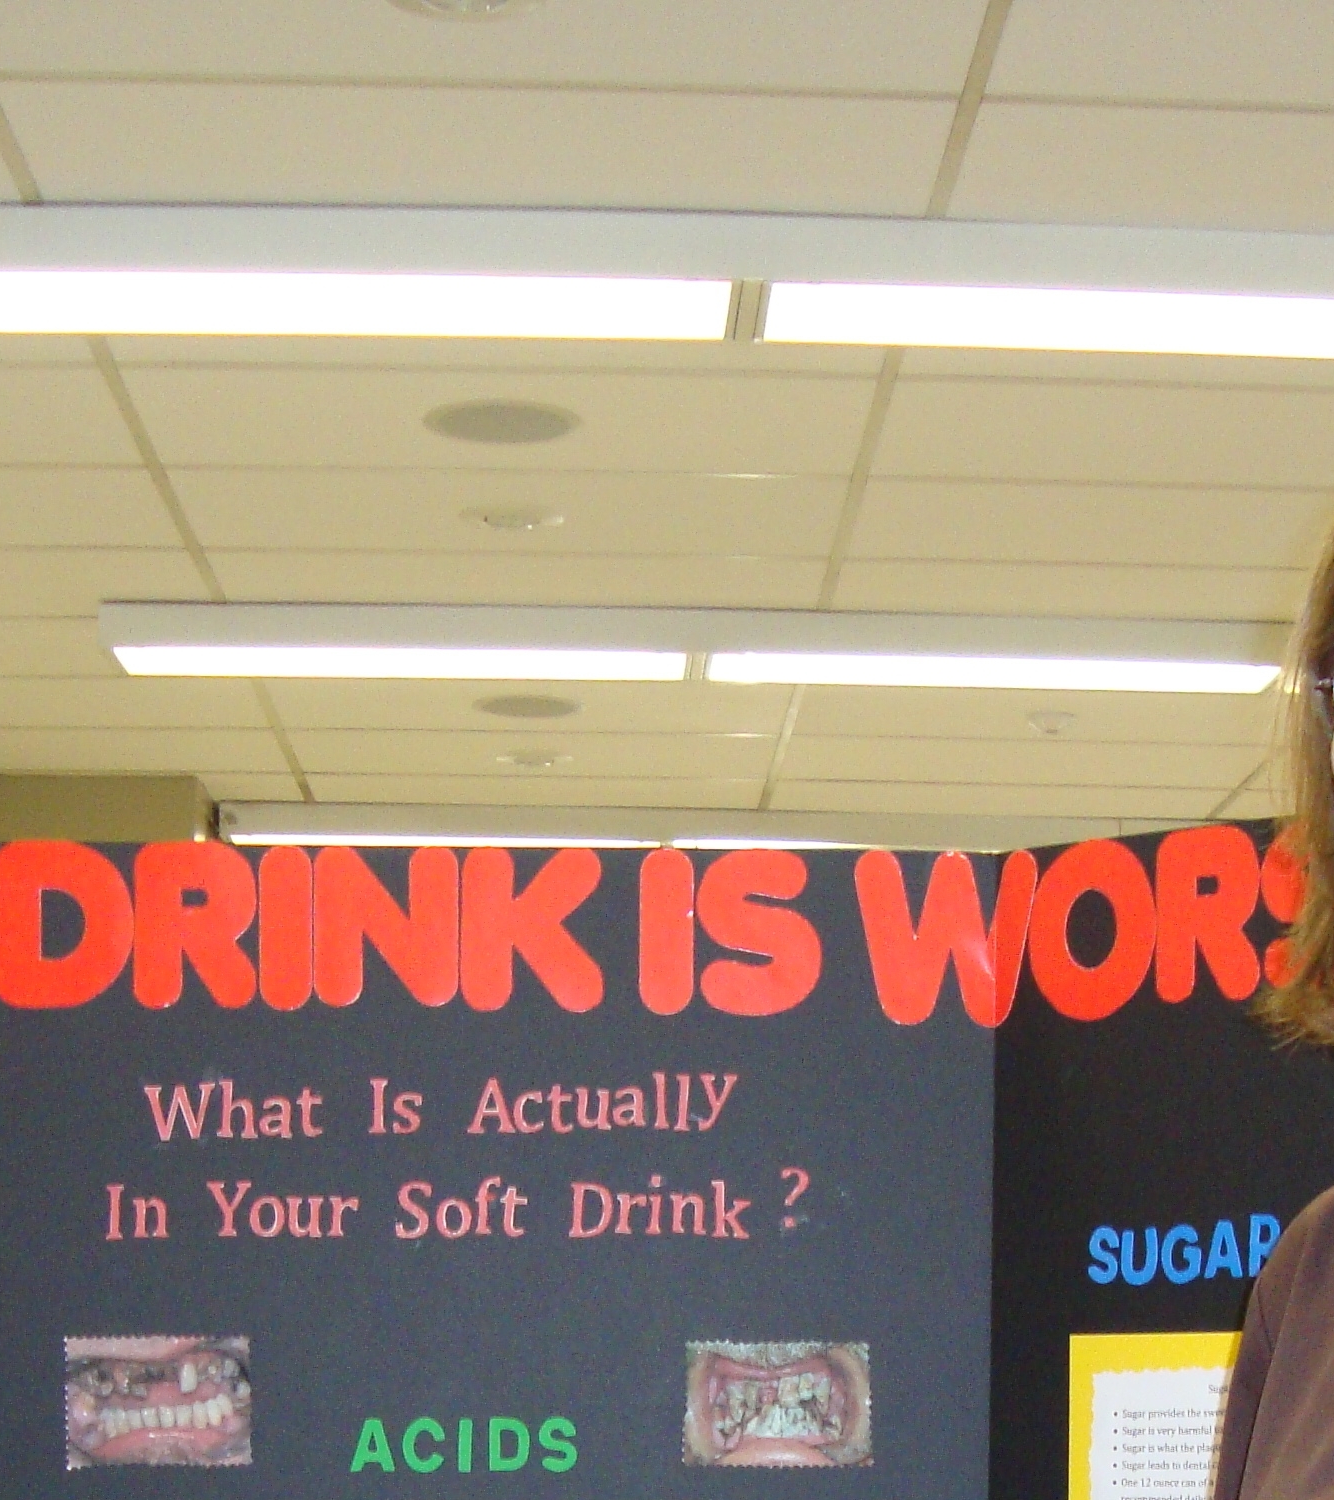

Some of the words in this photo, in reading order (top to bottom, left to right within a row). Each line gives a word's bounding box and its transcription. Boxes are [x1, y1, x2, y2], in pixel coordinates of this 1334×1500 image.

[639, 847, 822, 1017] IS
[143, 1077, 323, 1142] What
[368, 1077, 423, 1134] Is
[467, 1071, 738, 1134] Actually
[106, 1181, 169, 1240] In
[207, 1179, 359, 1238] Your
[394, 1175, 528, 1240] Soft
[568, 1173, 751, 1239] Drink
[350, 1416, 578, 1473] ACIDS
